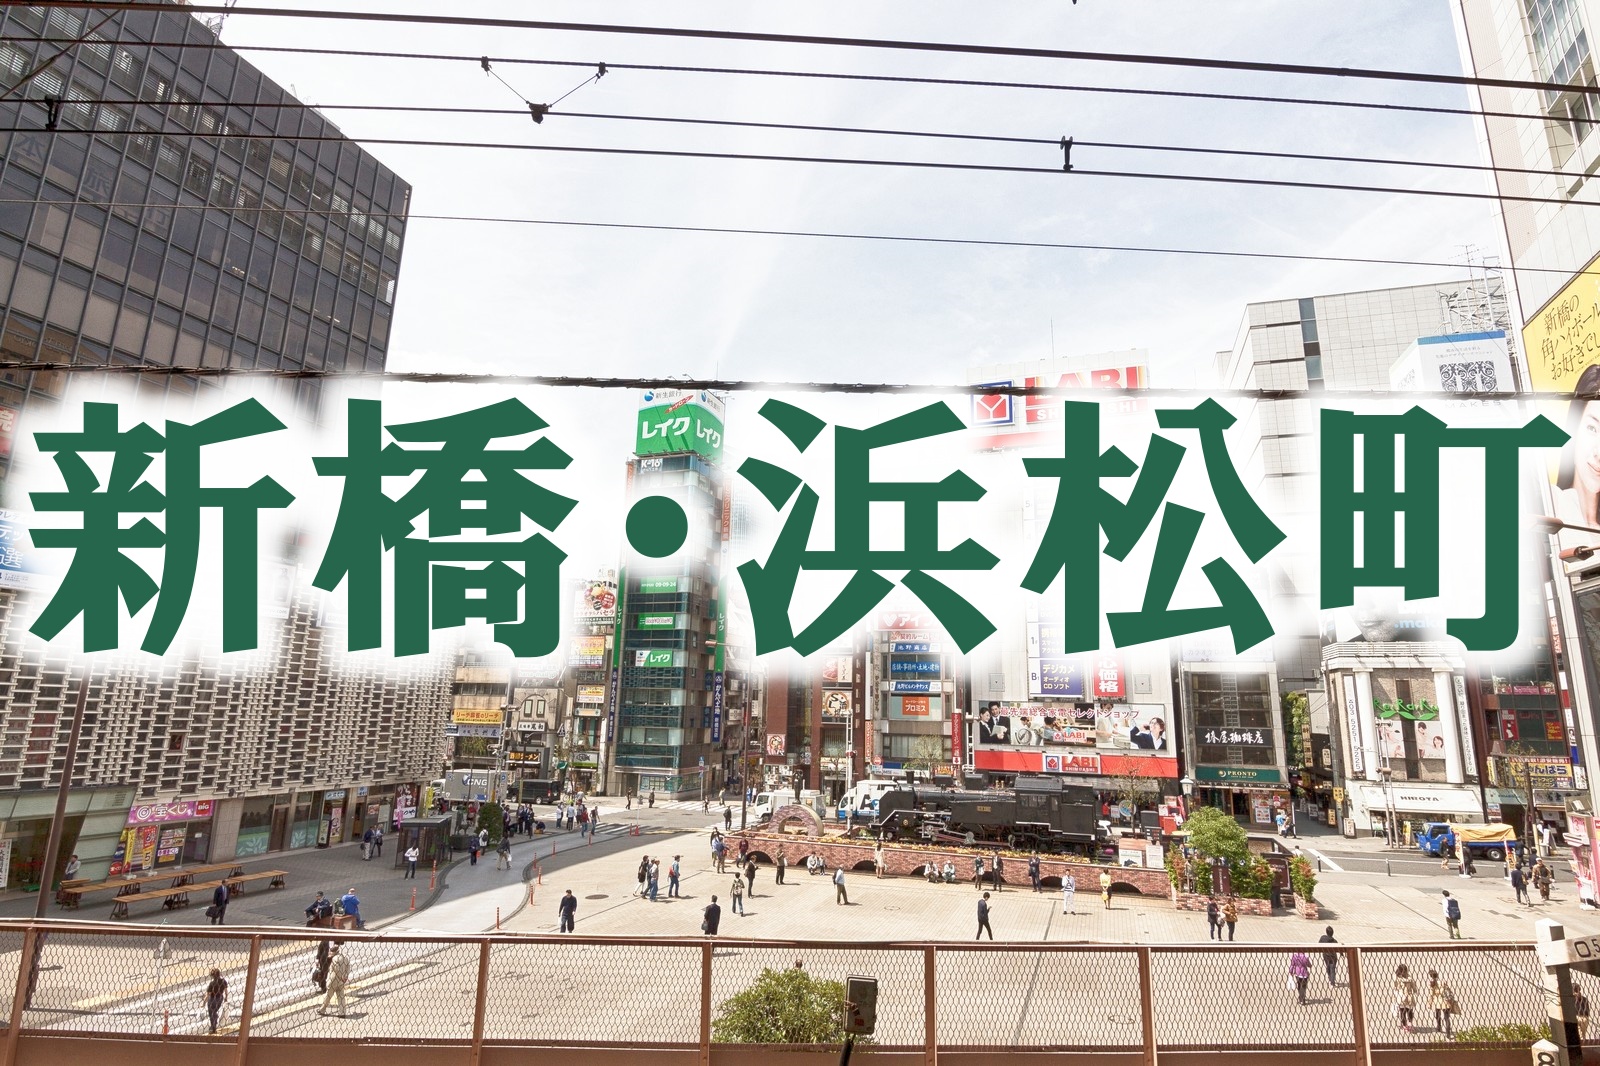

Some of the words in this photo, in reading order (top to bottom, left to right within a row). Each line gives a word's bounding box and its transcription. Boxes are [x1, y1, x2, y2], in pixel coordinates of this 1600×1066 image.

[1543, 294, 1580, 336] 新橋の
[1025, 366, 1138, 407] LABI
[656, 389, 682, 399] 新生銀行
[642, 417, 690, 439] レイク
[696, 419, 721, 448] レイク
[650, 654, 670, 662] レイク
[1043, 664, 1075, 674] デジカメ
[905, 704, 927, 712] プロミス
[1000, 707, 1140, 719] 最先端総合家電セレクトショップ
[1063, 731, 1086, 740] LABI
[1205, 730, 1264, 744] 椿屋珈琲店
[1062, 757, 1098, 768] LABI
[467, 778, 488, 787] CNG
[155, 804, 188, 817] 宝くじ
